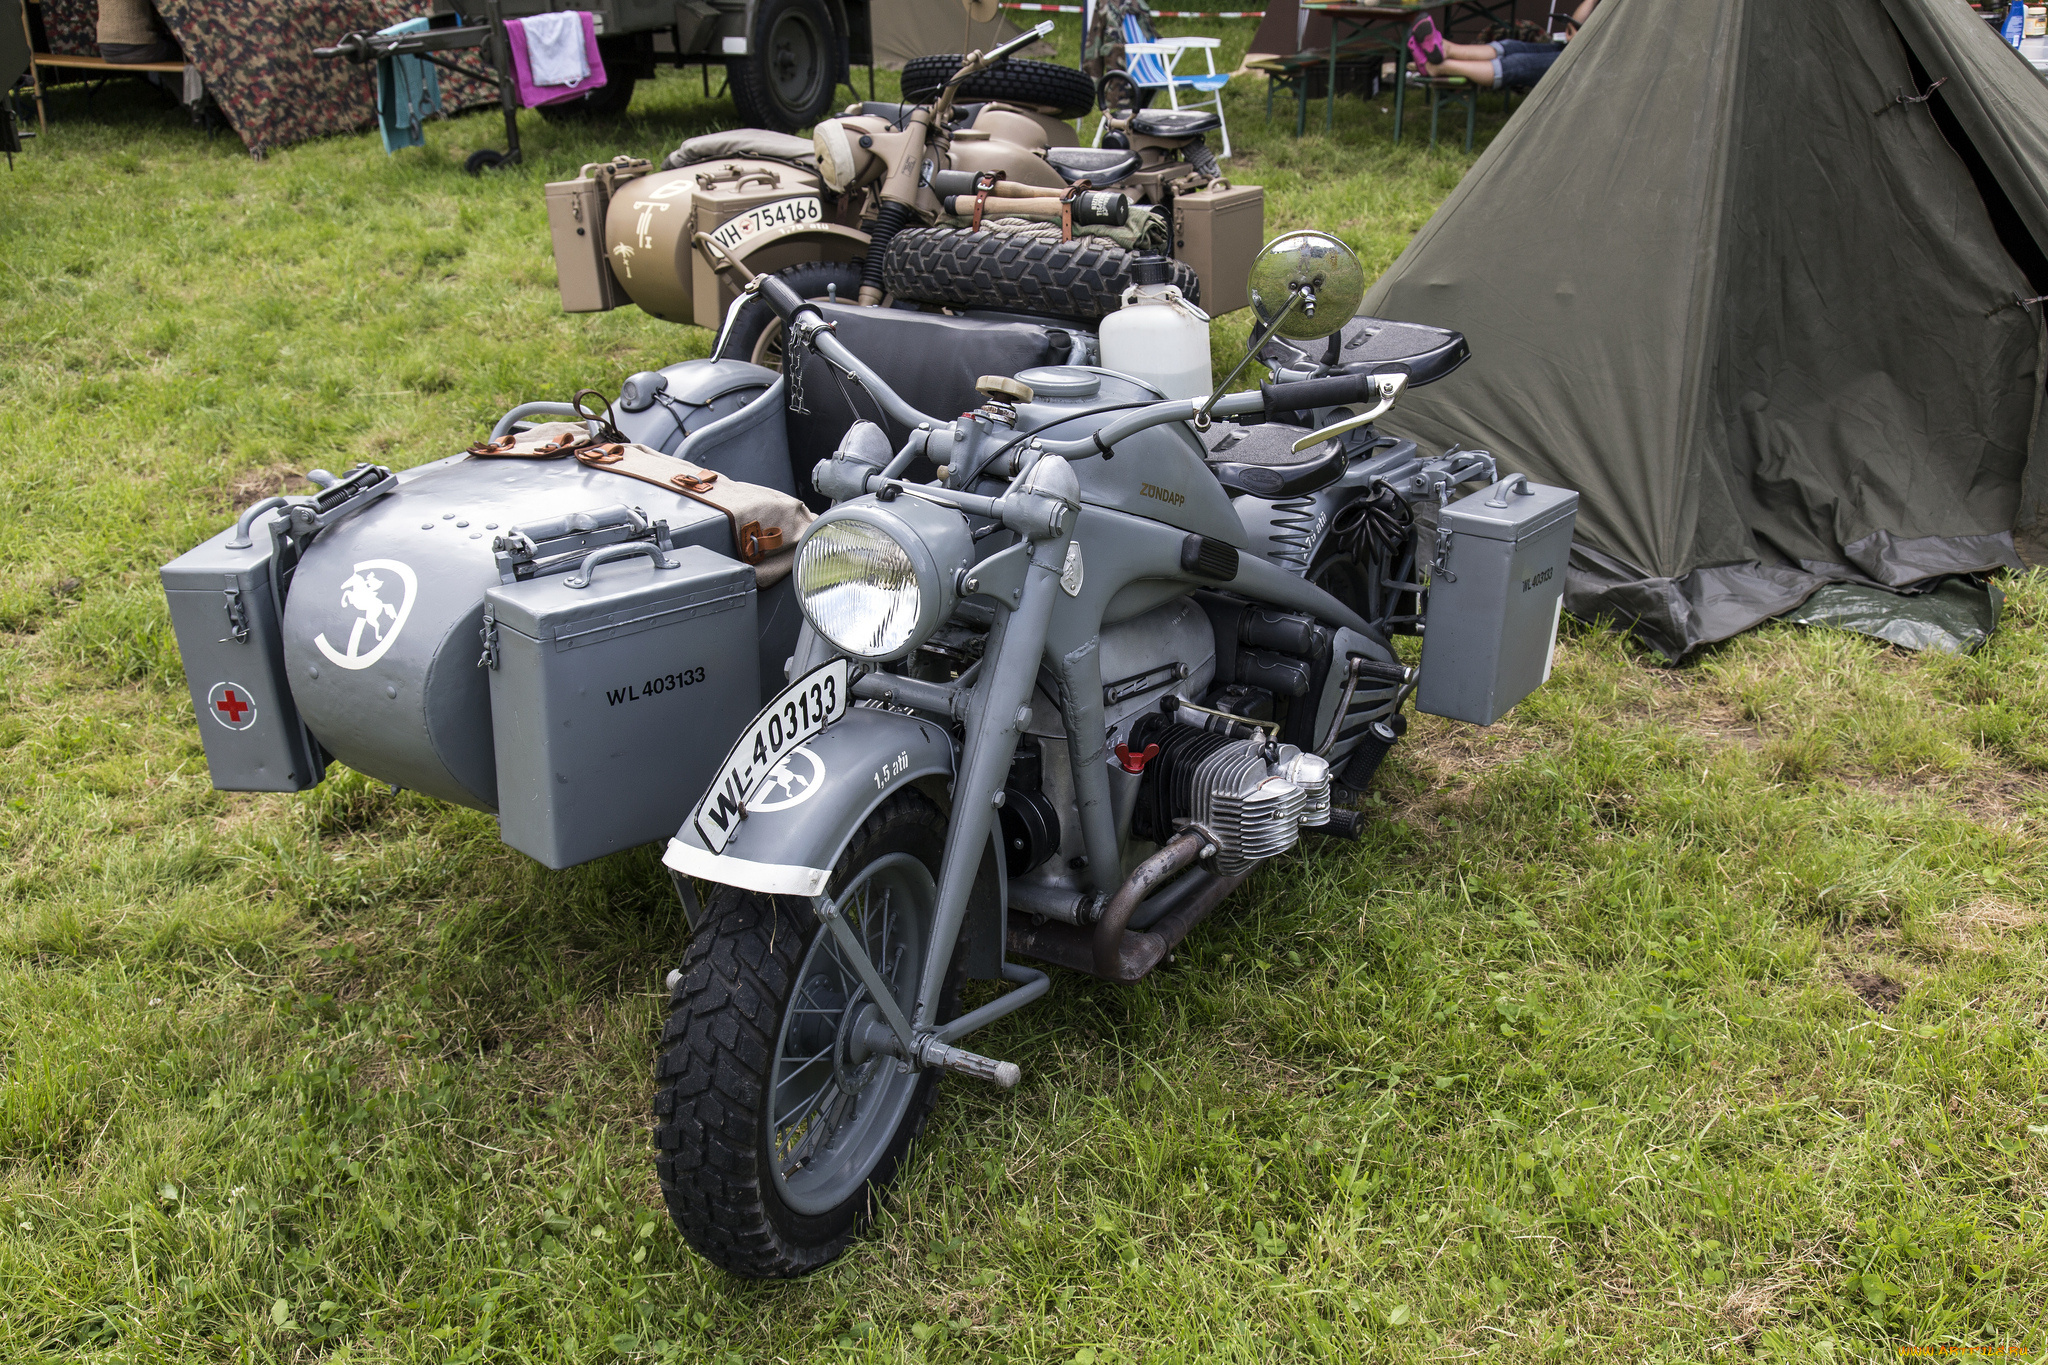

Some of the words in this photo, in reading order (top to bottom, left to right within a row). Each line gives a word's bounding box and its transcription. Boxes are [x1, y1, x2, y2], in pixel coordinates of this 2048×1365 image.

[749, 200, 818, 231] 754166
[1139, 482, 1185, 508] ZÜNDAPP
[1522, 578, 1532, 593] WL
[1531, 566, 1554, 588] 403133
[606, 685, 640, 707] WL
[642, 666, 706, 697] 403133
[873, 763, 890, 790] 1,5
[892, 750, 909, 776] atü
